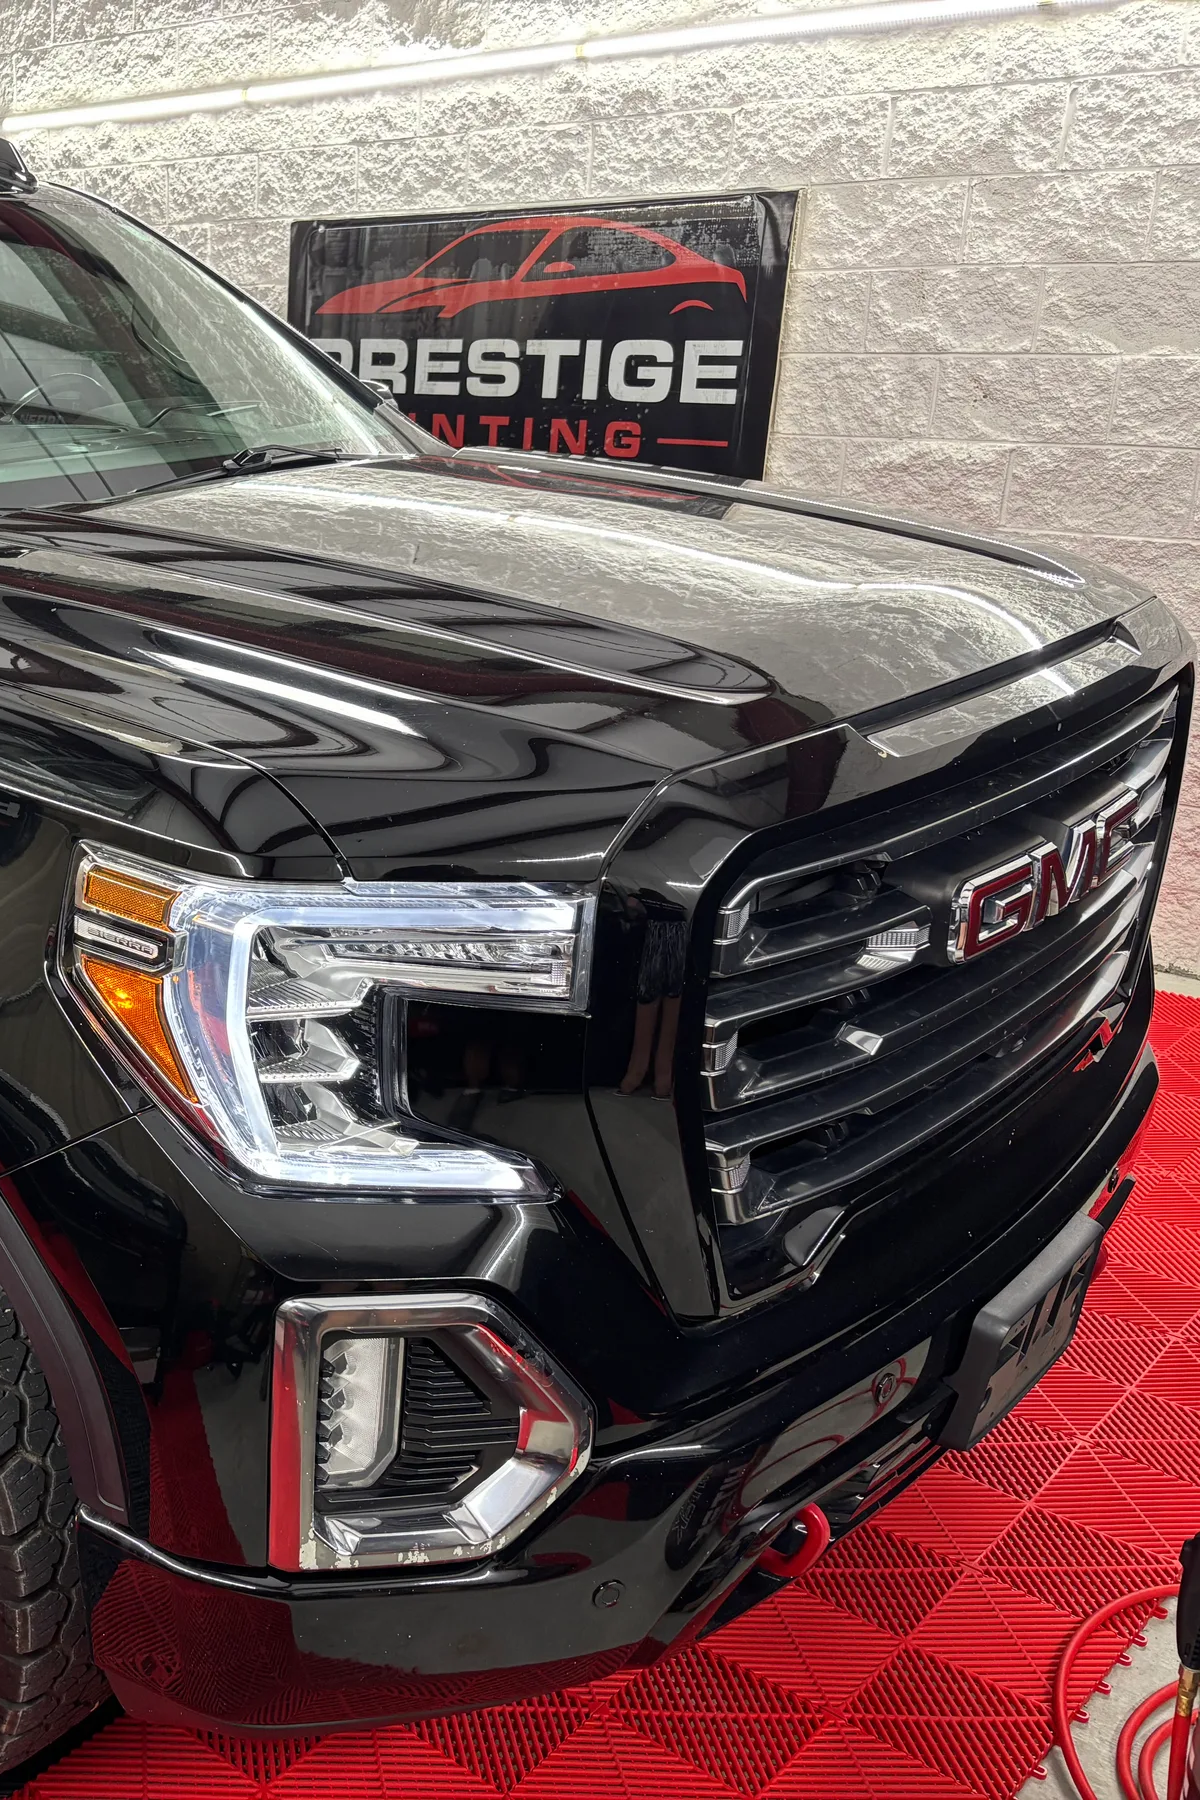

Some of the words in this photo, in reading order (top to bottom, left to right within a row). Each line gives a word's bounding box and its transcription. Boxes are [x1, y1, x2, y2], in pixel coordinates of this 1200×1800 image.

[407, 412, 642, 458] NTING
[947, 787, 1139, 964] GMC
[87, 926, 155, 956] SIERRA
